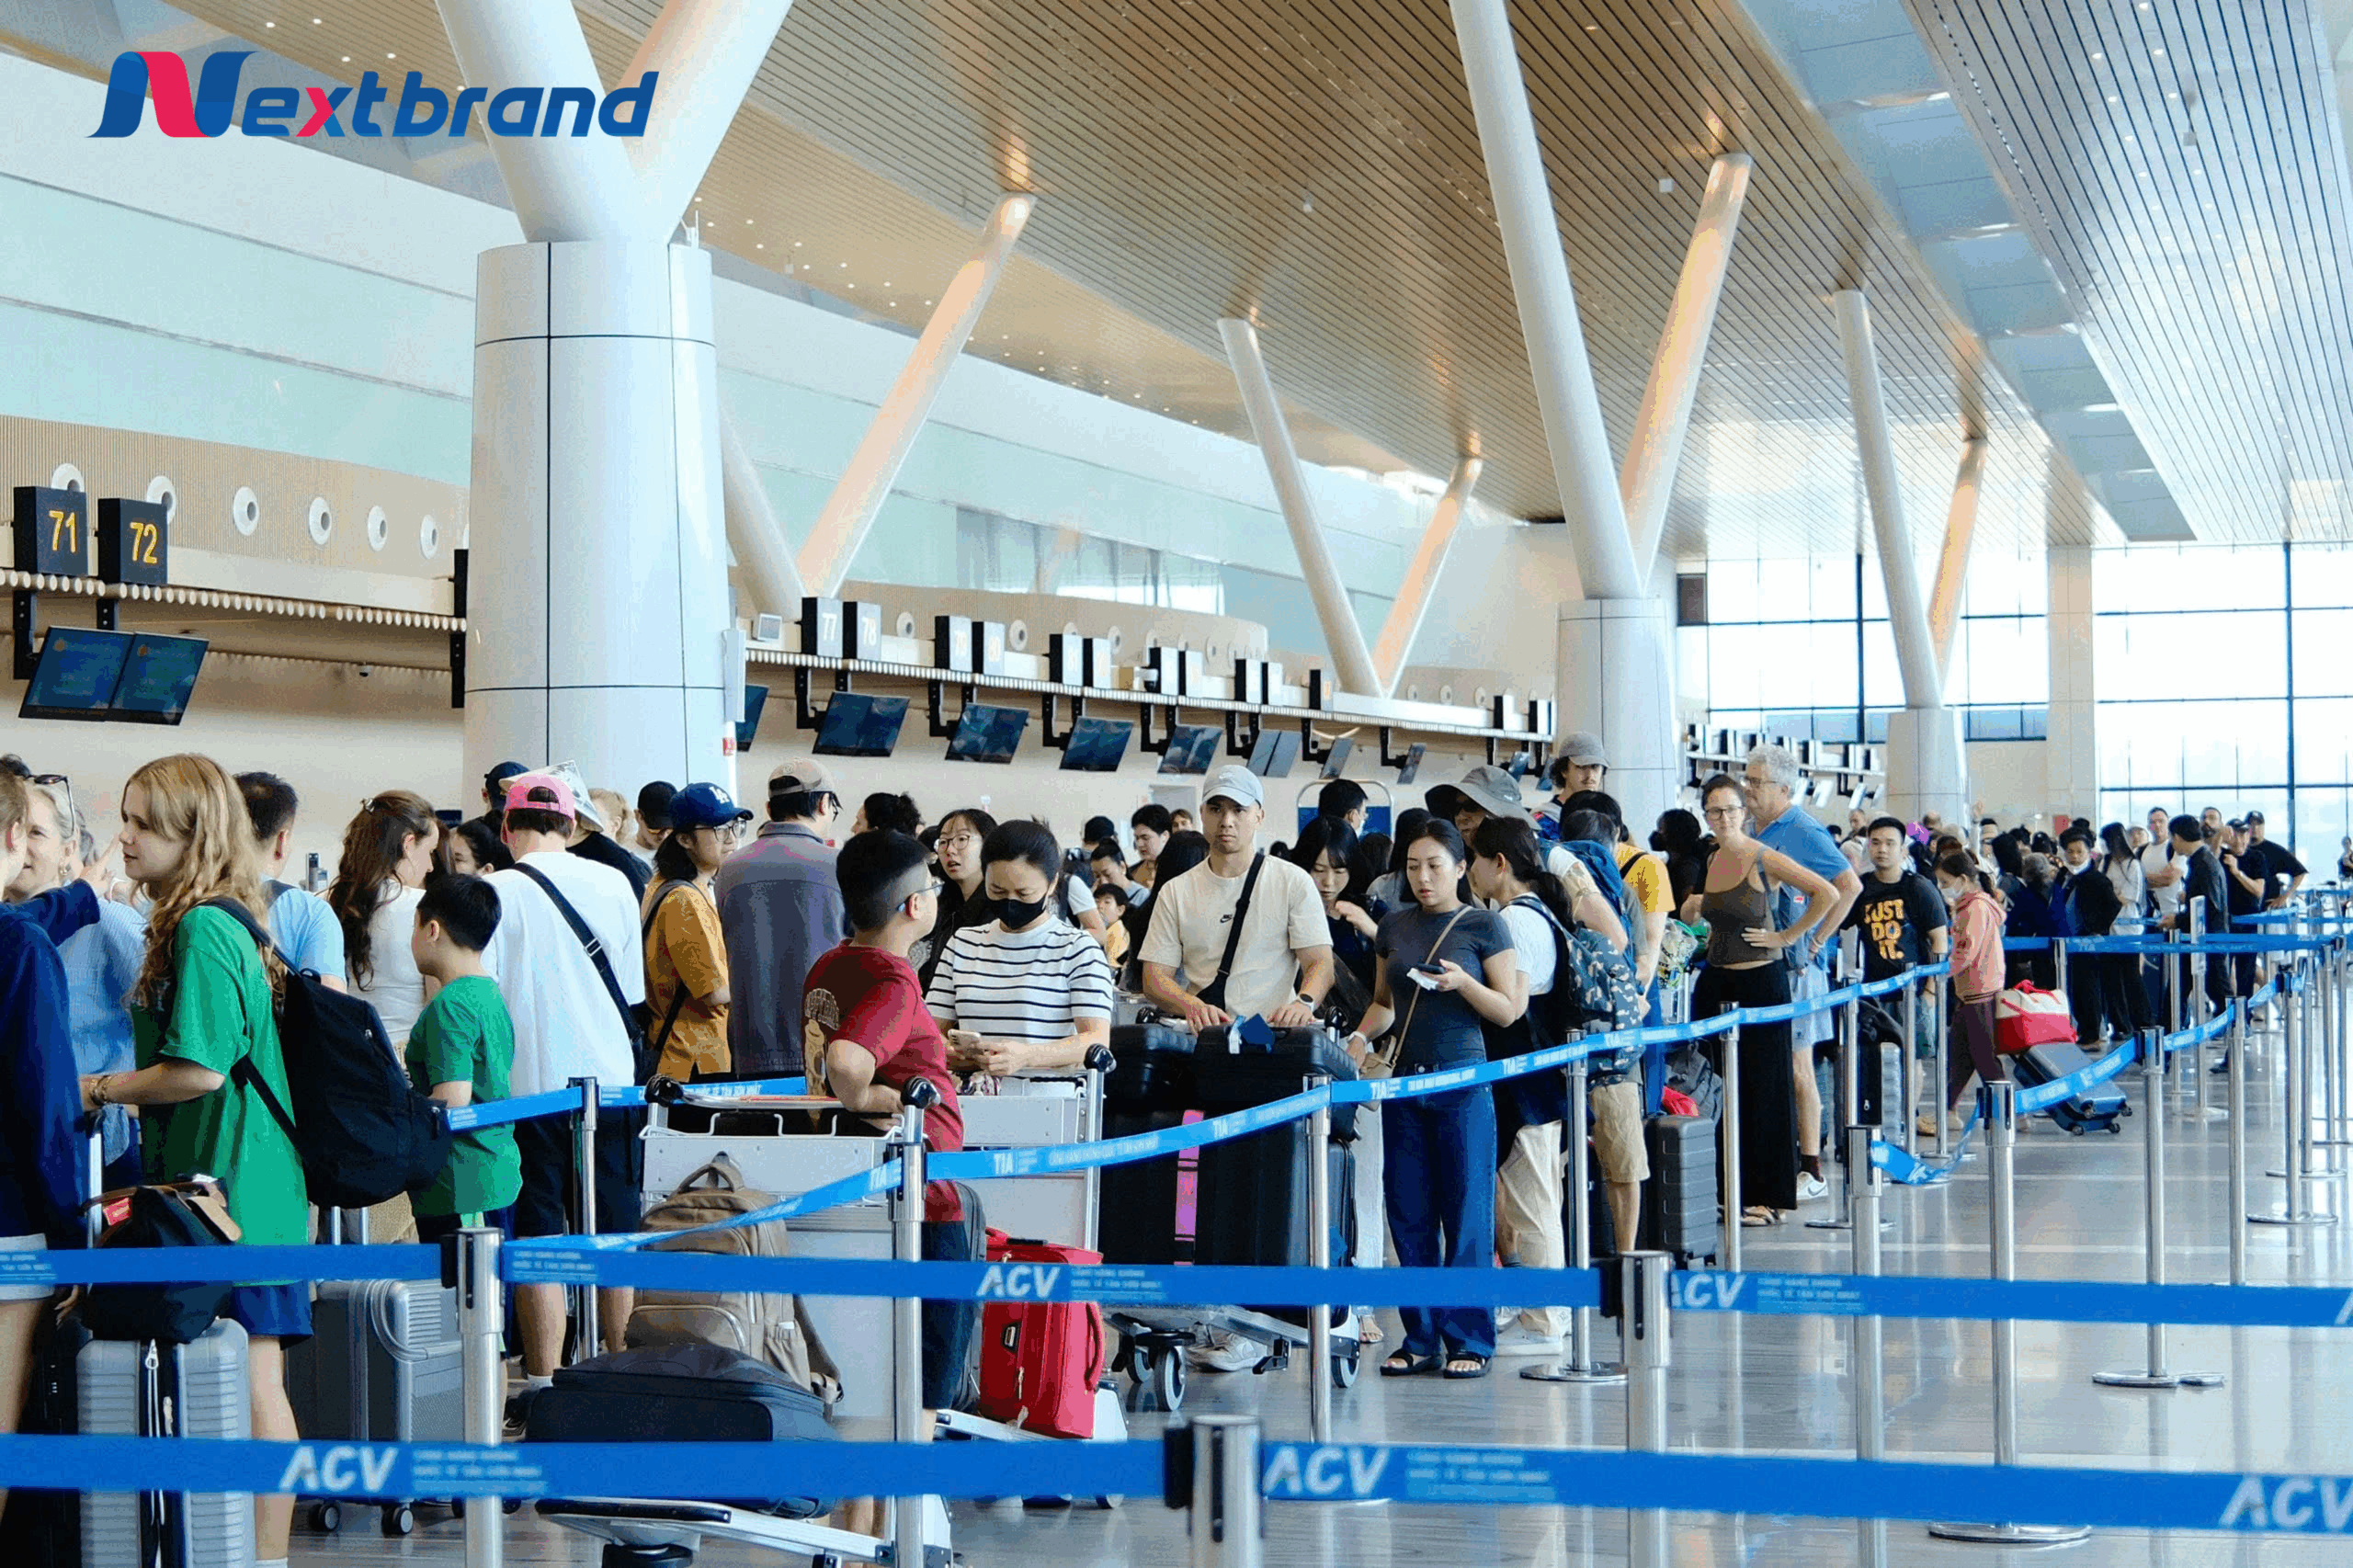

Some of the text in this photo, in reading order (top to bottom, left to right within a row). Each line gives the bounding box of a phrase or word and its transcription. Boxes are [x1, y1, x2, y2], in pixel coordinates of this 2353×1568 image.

[49, 510, 76, 553] 71
[130, 522, 158, 563] 72
[822, 612, 837, 641] 77
[861, 616, 877, 646] 78
[709, 786, 730, 804] LA
[1864, 899, 1904, 925] JUST
[1871, 920, 1902, 941] DO
[1879, 939, 1904, 960] IT.
[1370, 1081, 1387, 1099] TIA
[994, 1153, 1014, 1176] TIA
[975, 1265, 1061, 1299] ACV
[278, 1445, 399, 1493] ACV
[1262, 1446, 1390, 1495] ACV
[2218, 1477, 2353, 1528] ACV
